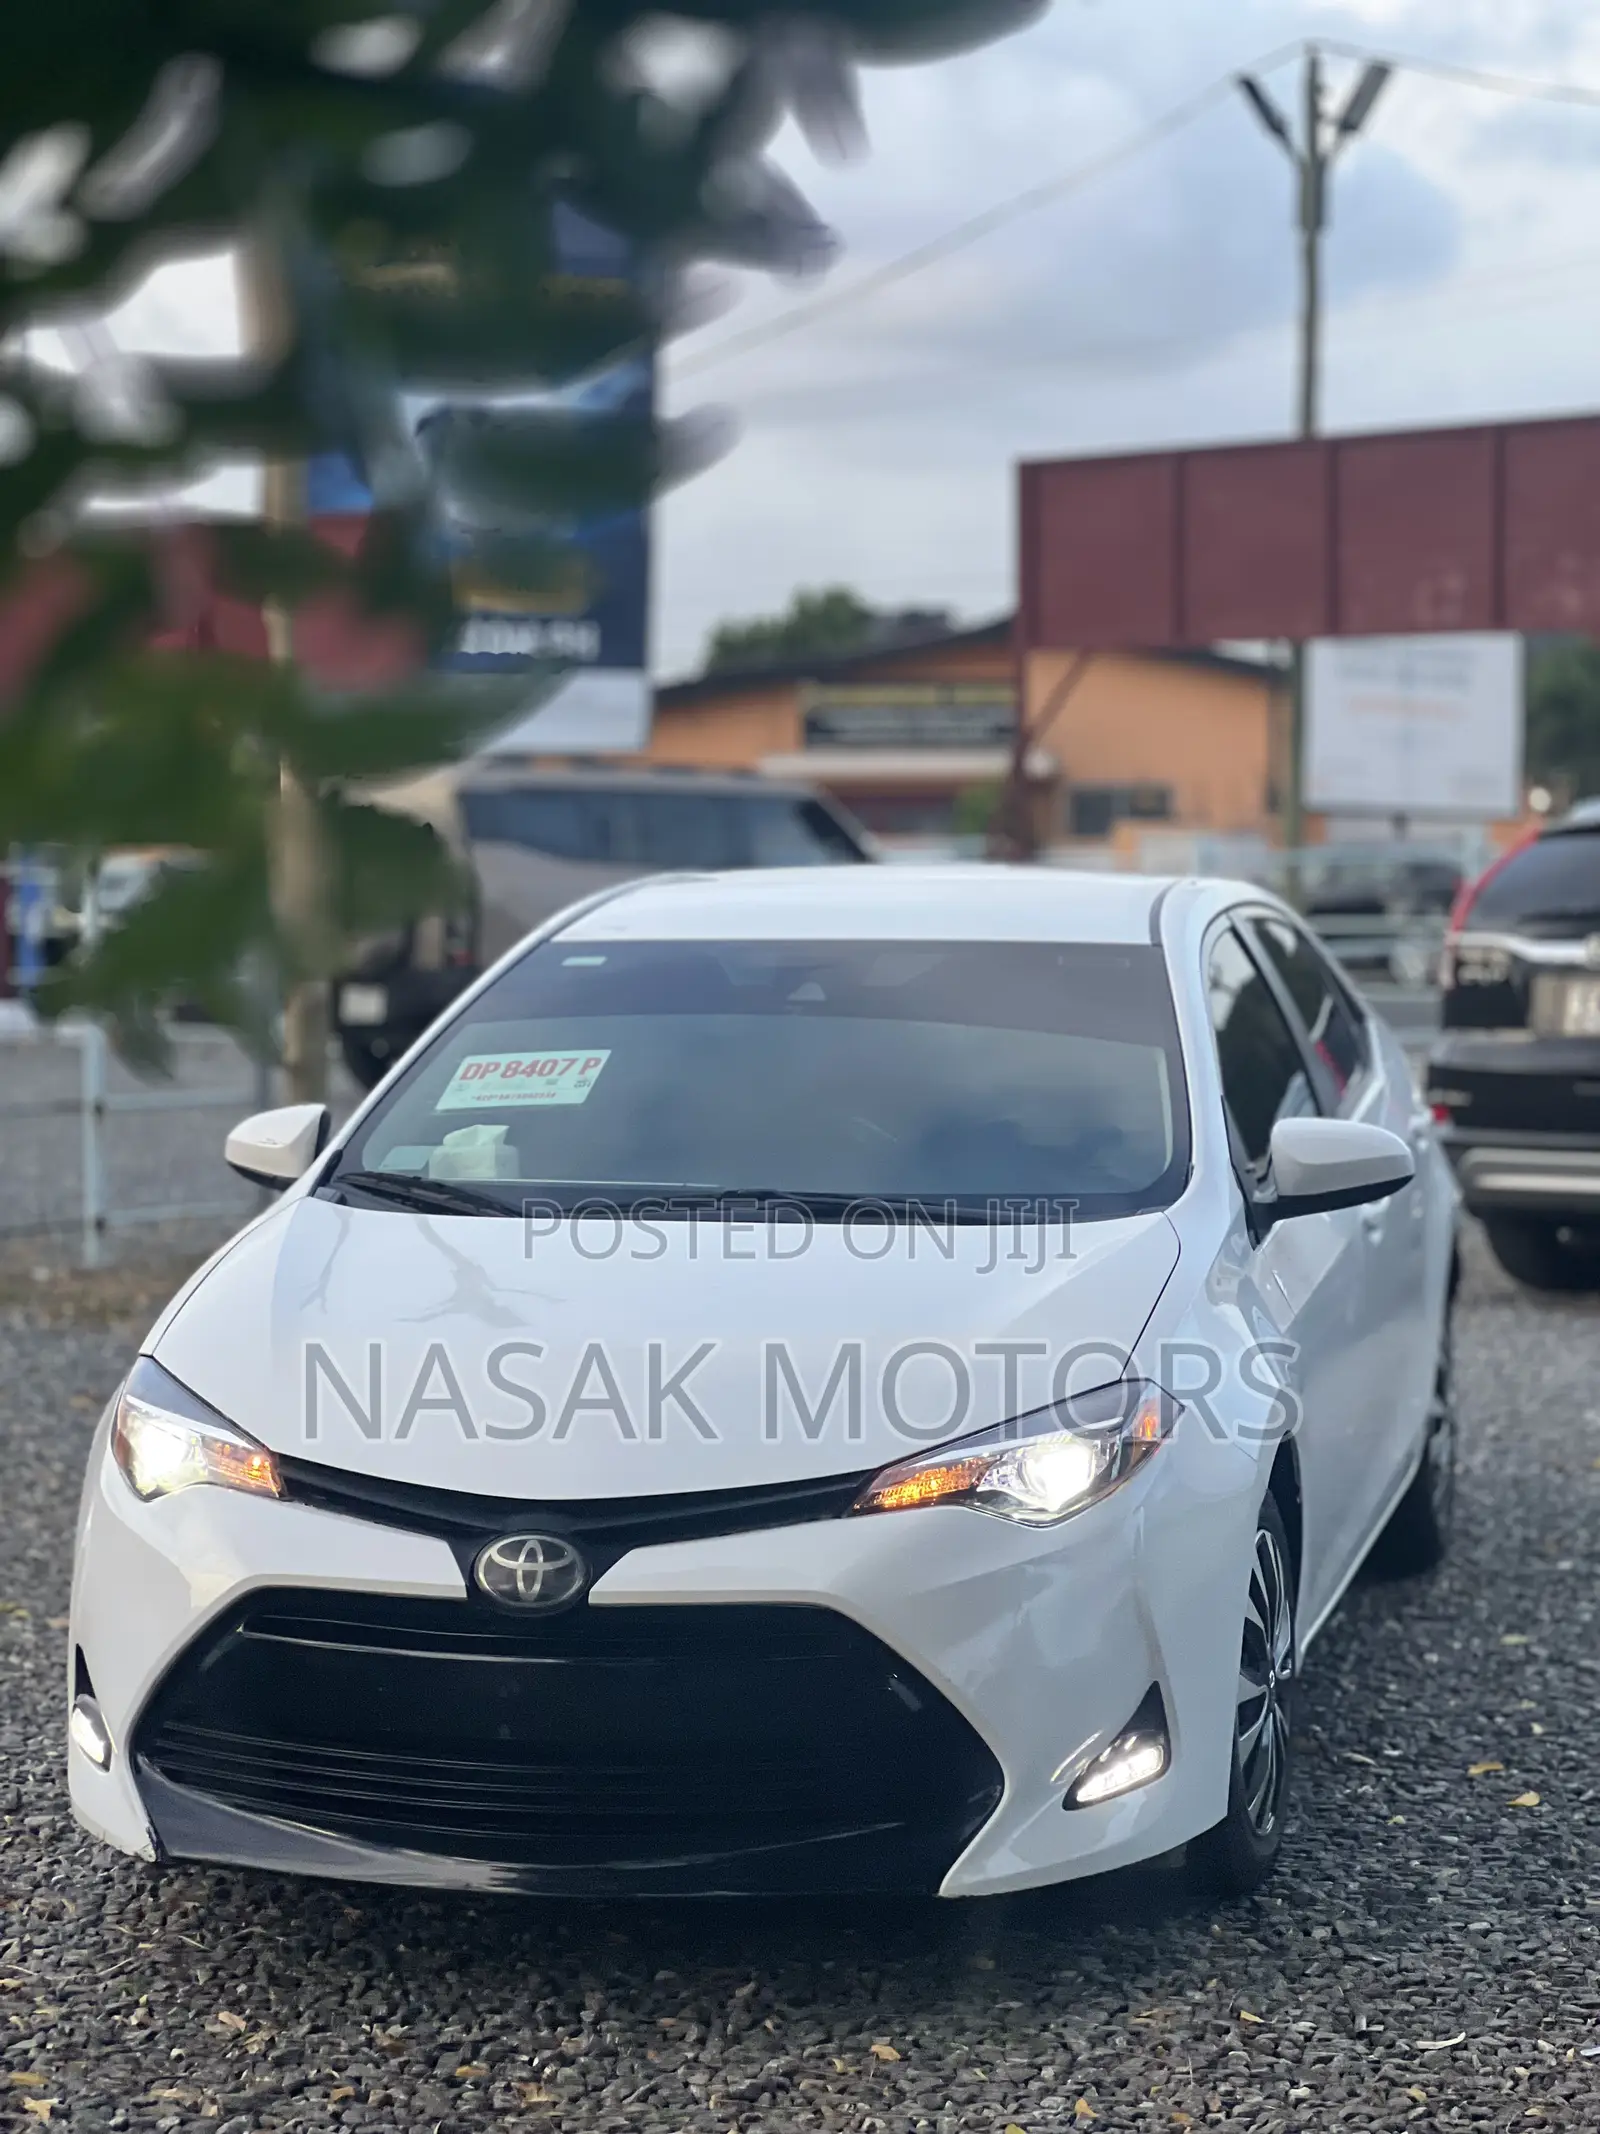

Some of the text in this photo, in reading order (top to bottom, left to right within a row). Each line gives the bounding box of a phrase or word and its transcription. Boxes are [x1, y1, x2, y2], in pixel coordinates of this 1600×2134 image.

[459, 1057, 602, 1081] DP 8407 P
